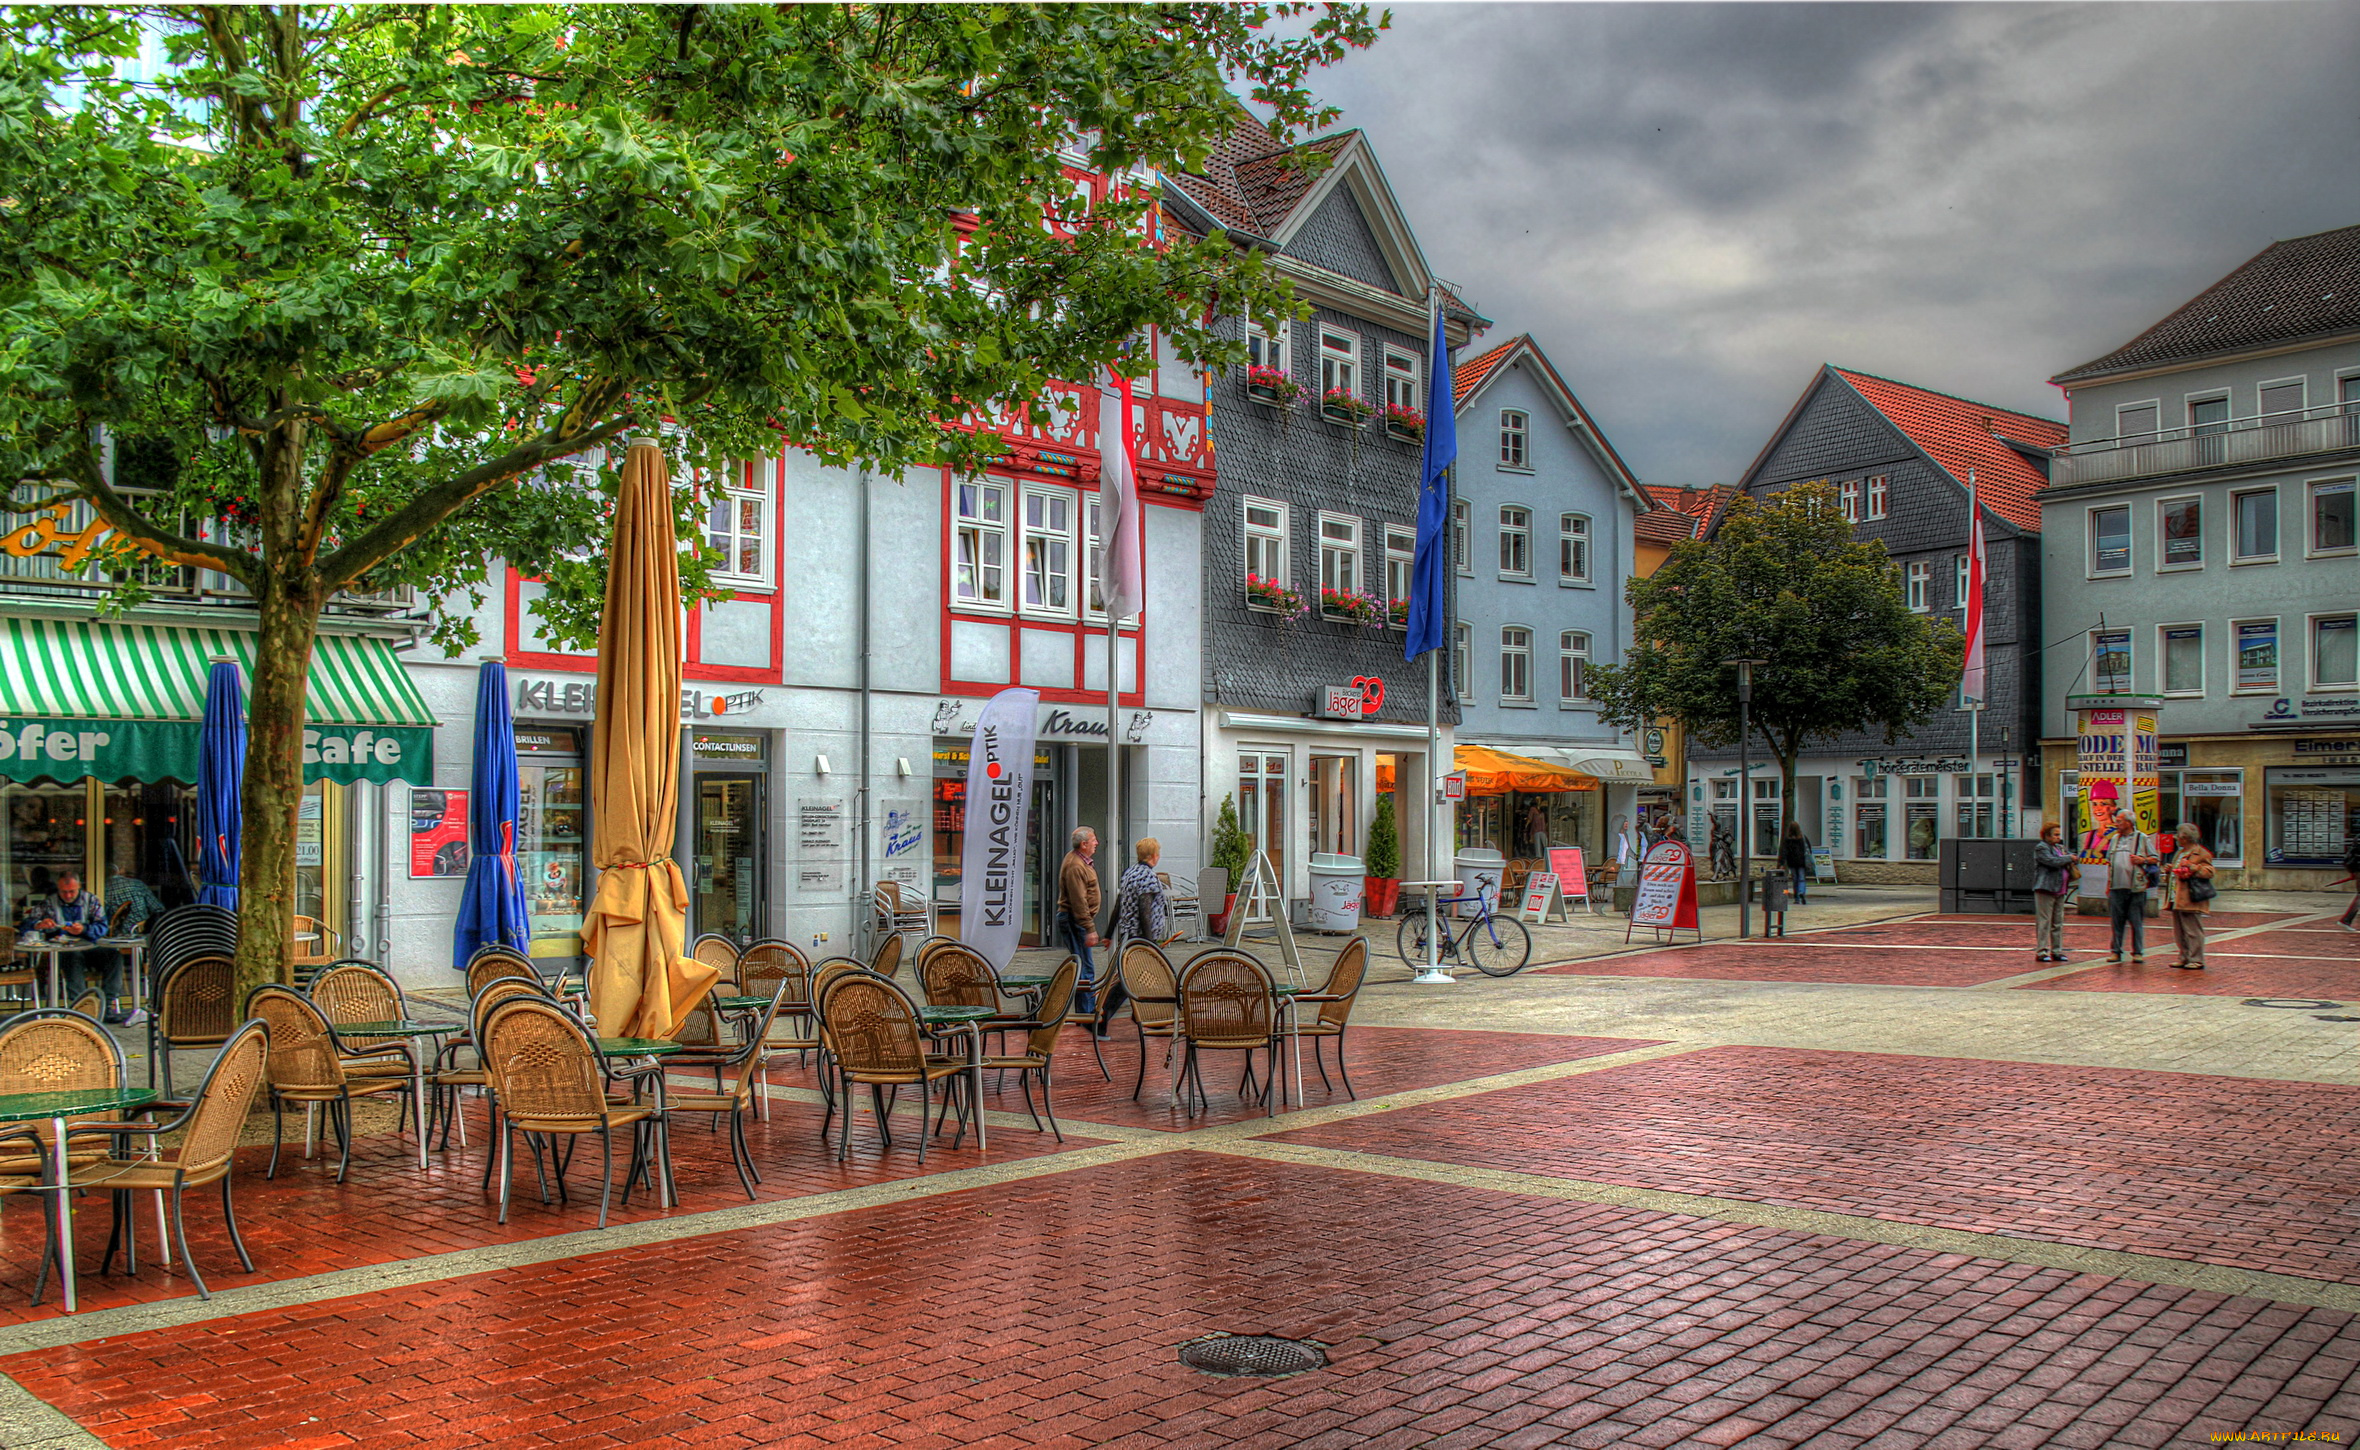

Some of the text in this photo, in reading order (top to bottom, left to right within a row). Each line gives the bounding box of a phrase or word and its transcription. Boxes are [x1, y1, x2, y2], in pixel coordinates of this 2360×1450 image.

[520, 679, 710, 719] KLEIEL
[1326, 691, 1361, 717] Jäger
[2092, 712, 2123, 720] ADLER
[303, 730, 401, 764] Cafe
[515, 735, 551, 745] BRILLEN
[693, 741, 757, 753] CONTACTLINSEN
[932, 751, 951, 759] Wurst
[1878, 761, 1970, 776] hörgerätemeister
[886, 831, 922, 857] Kraus
[985, 771, 1013, 926] KLEINAGEL
